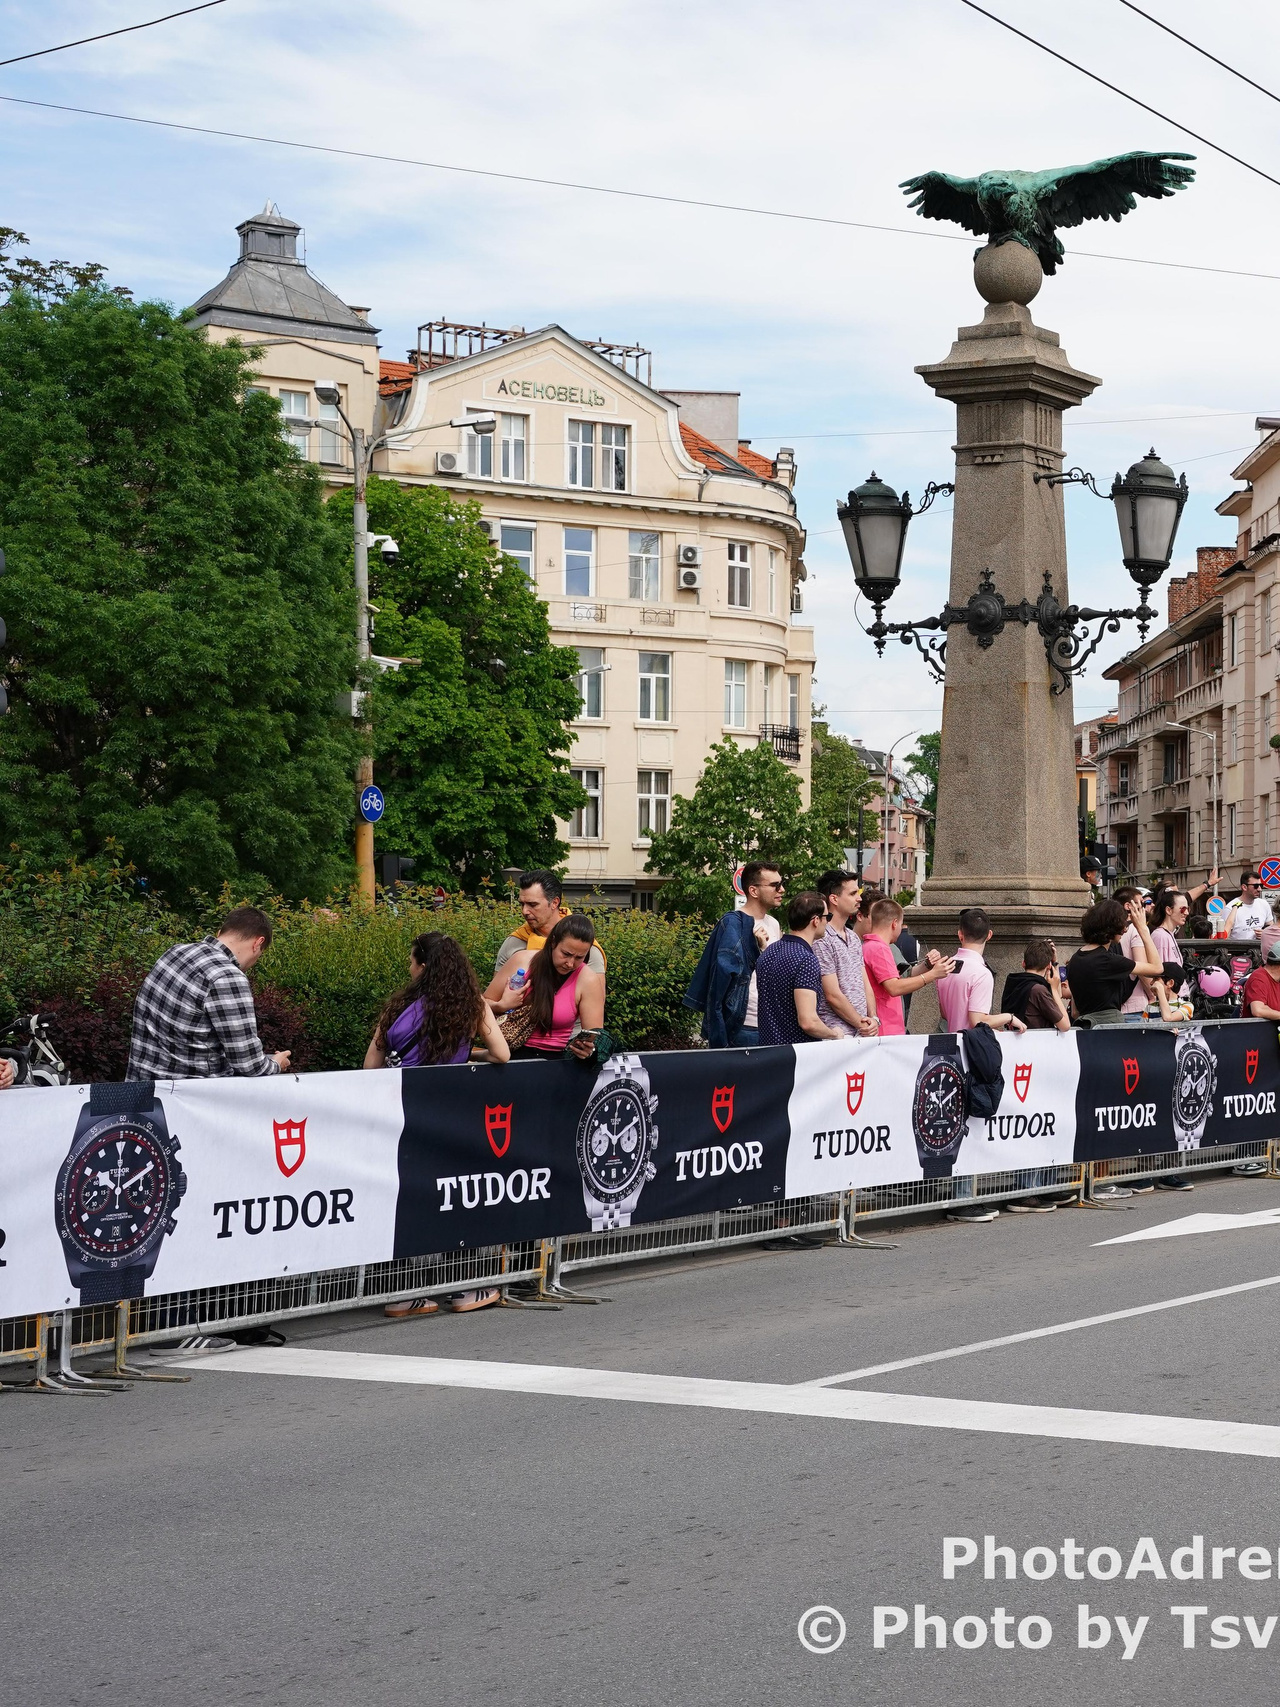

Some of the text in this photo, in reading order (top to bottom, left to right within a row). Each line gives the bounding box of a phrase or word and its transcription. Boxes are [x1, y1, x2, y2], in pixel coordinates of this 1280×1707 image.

[497, 379, 606, 407] АСЕНОВЕЦЪ
[1095, 1103, 1157, 1132] TUDOR
[1223, 1092, 1276, 1118] TUDOR
[813, 1125, 892, 1160] TUDOR
[985, 1112, 1056, 1142] TUDOR
[675, 1141, 763, 1182] TUDOR
[436, 1167, 552, 1212] TUDOR
[213, 1188, 355, 1239] TUDOR
